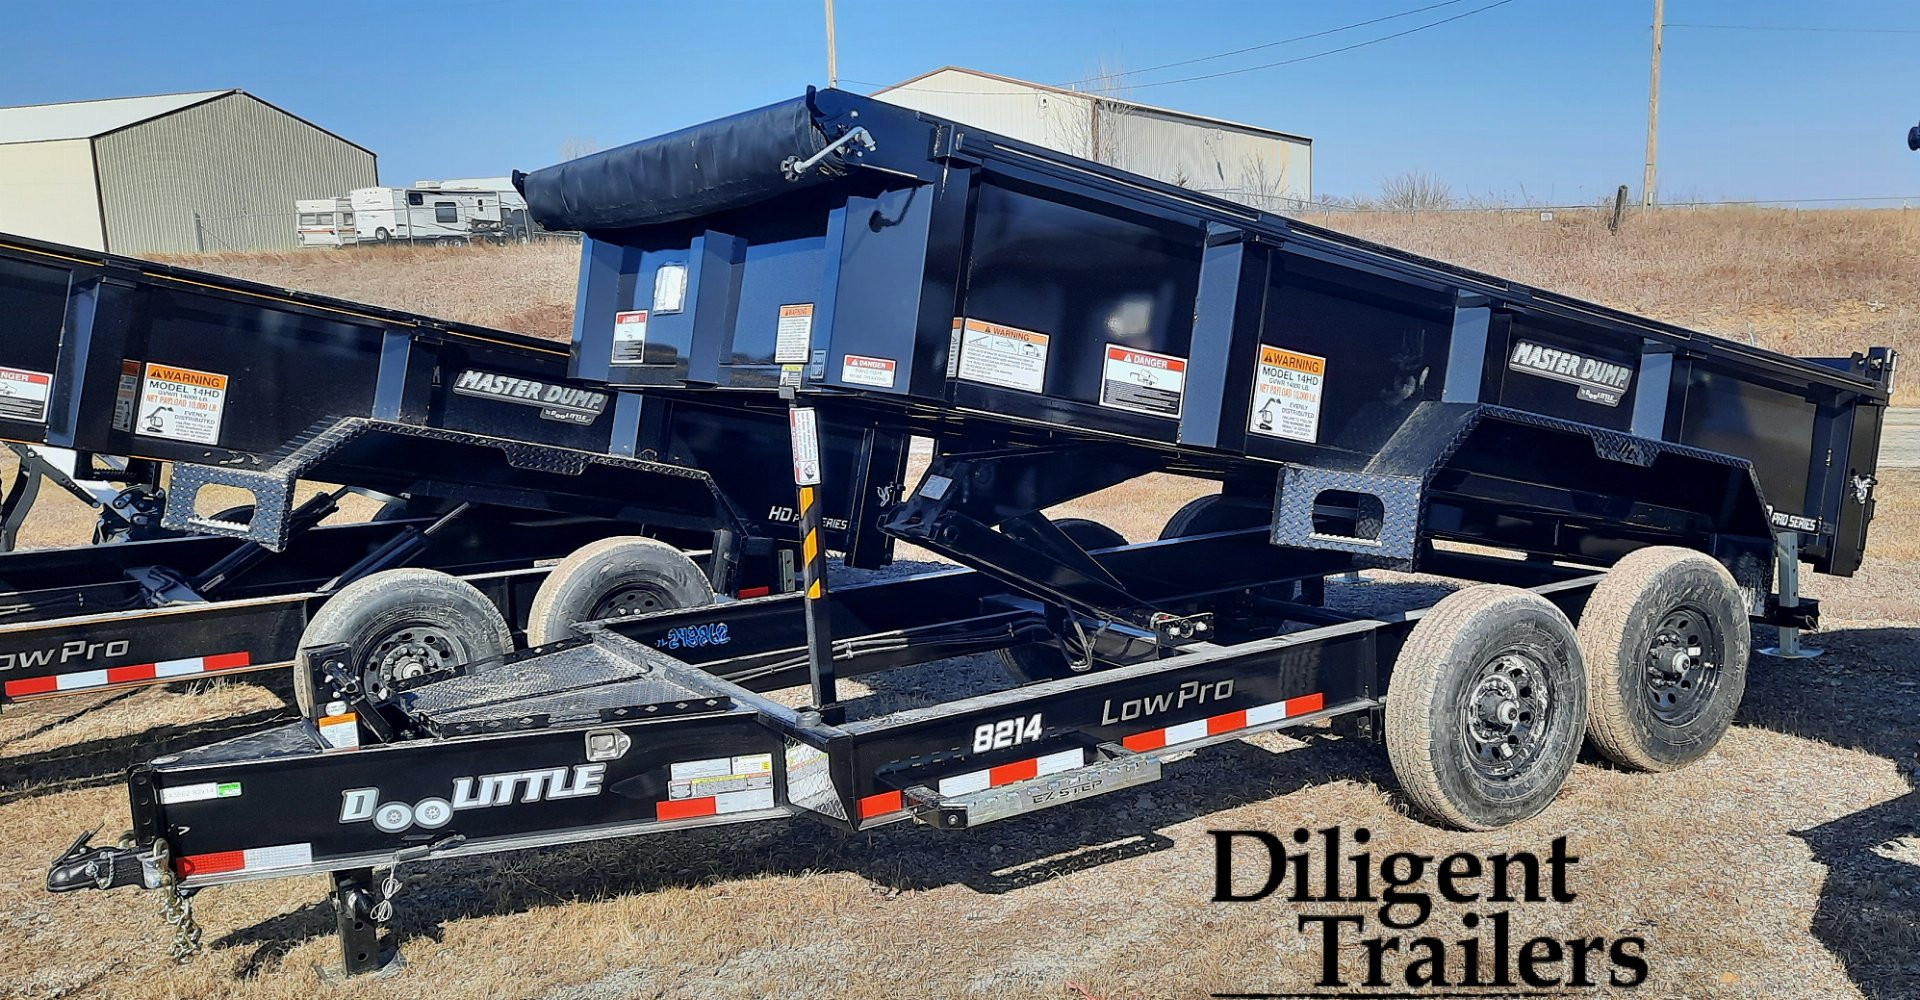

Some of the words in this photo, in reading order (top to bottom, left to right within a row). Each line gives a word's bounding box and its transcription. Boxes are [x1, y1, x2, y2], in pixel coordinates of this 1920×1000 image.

[992, 326, 1030, 342] WARNING
[859, 360, 886, 369] DANGER
[1133, 355, 1168, 369] DANGER
[1274, 353, 1320, 373] WARNING
[1513, 342, 1580, 376] MASTER
[0, 371, 29, 382] NGER
[163, 369, 220, 387] WARNING
[457, 370, 542, 400] MASTER
[1262, 366, 1293, 381] MODEL
[1297, 373, 1319, 386] 14HD
[1269, 377, 1286, 386] GVWR
[149, 380, 189, 394] MODEL
[193, 387, 220, 398] 14HD
[146, 394, 158, 403] NET
[160, 396, 188, 408] PAYLOAD
[768, 505, 793, 521] HD
[822, 516, 848, 530] ERIES
[1771, 512, 1789, 526] PRO
[1788, 515, 1817, 531] SERIES
[0, 640, 129, 671] owPro
[1101, 679, 1235, 726] LowPro
[972, 712, 1043, 754] 8214
[338, 762, 608, 834] DOOLITTLE
[1059, 779, 1104, 798] STEP
